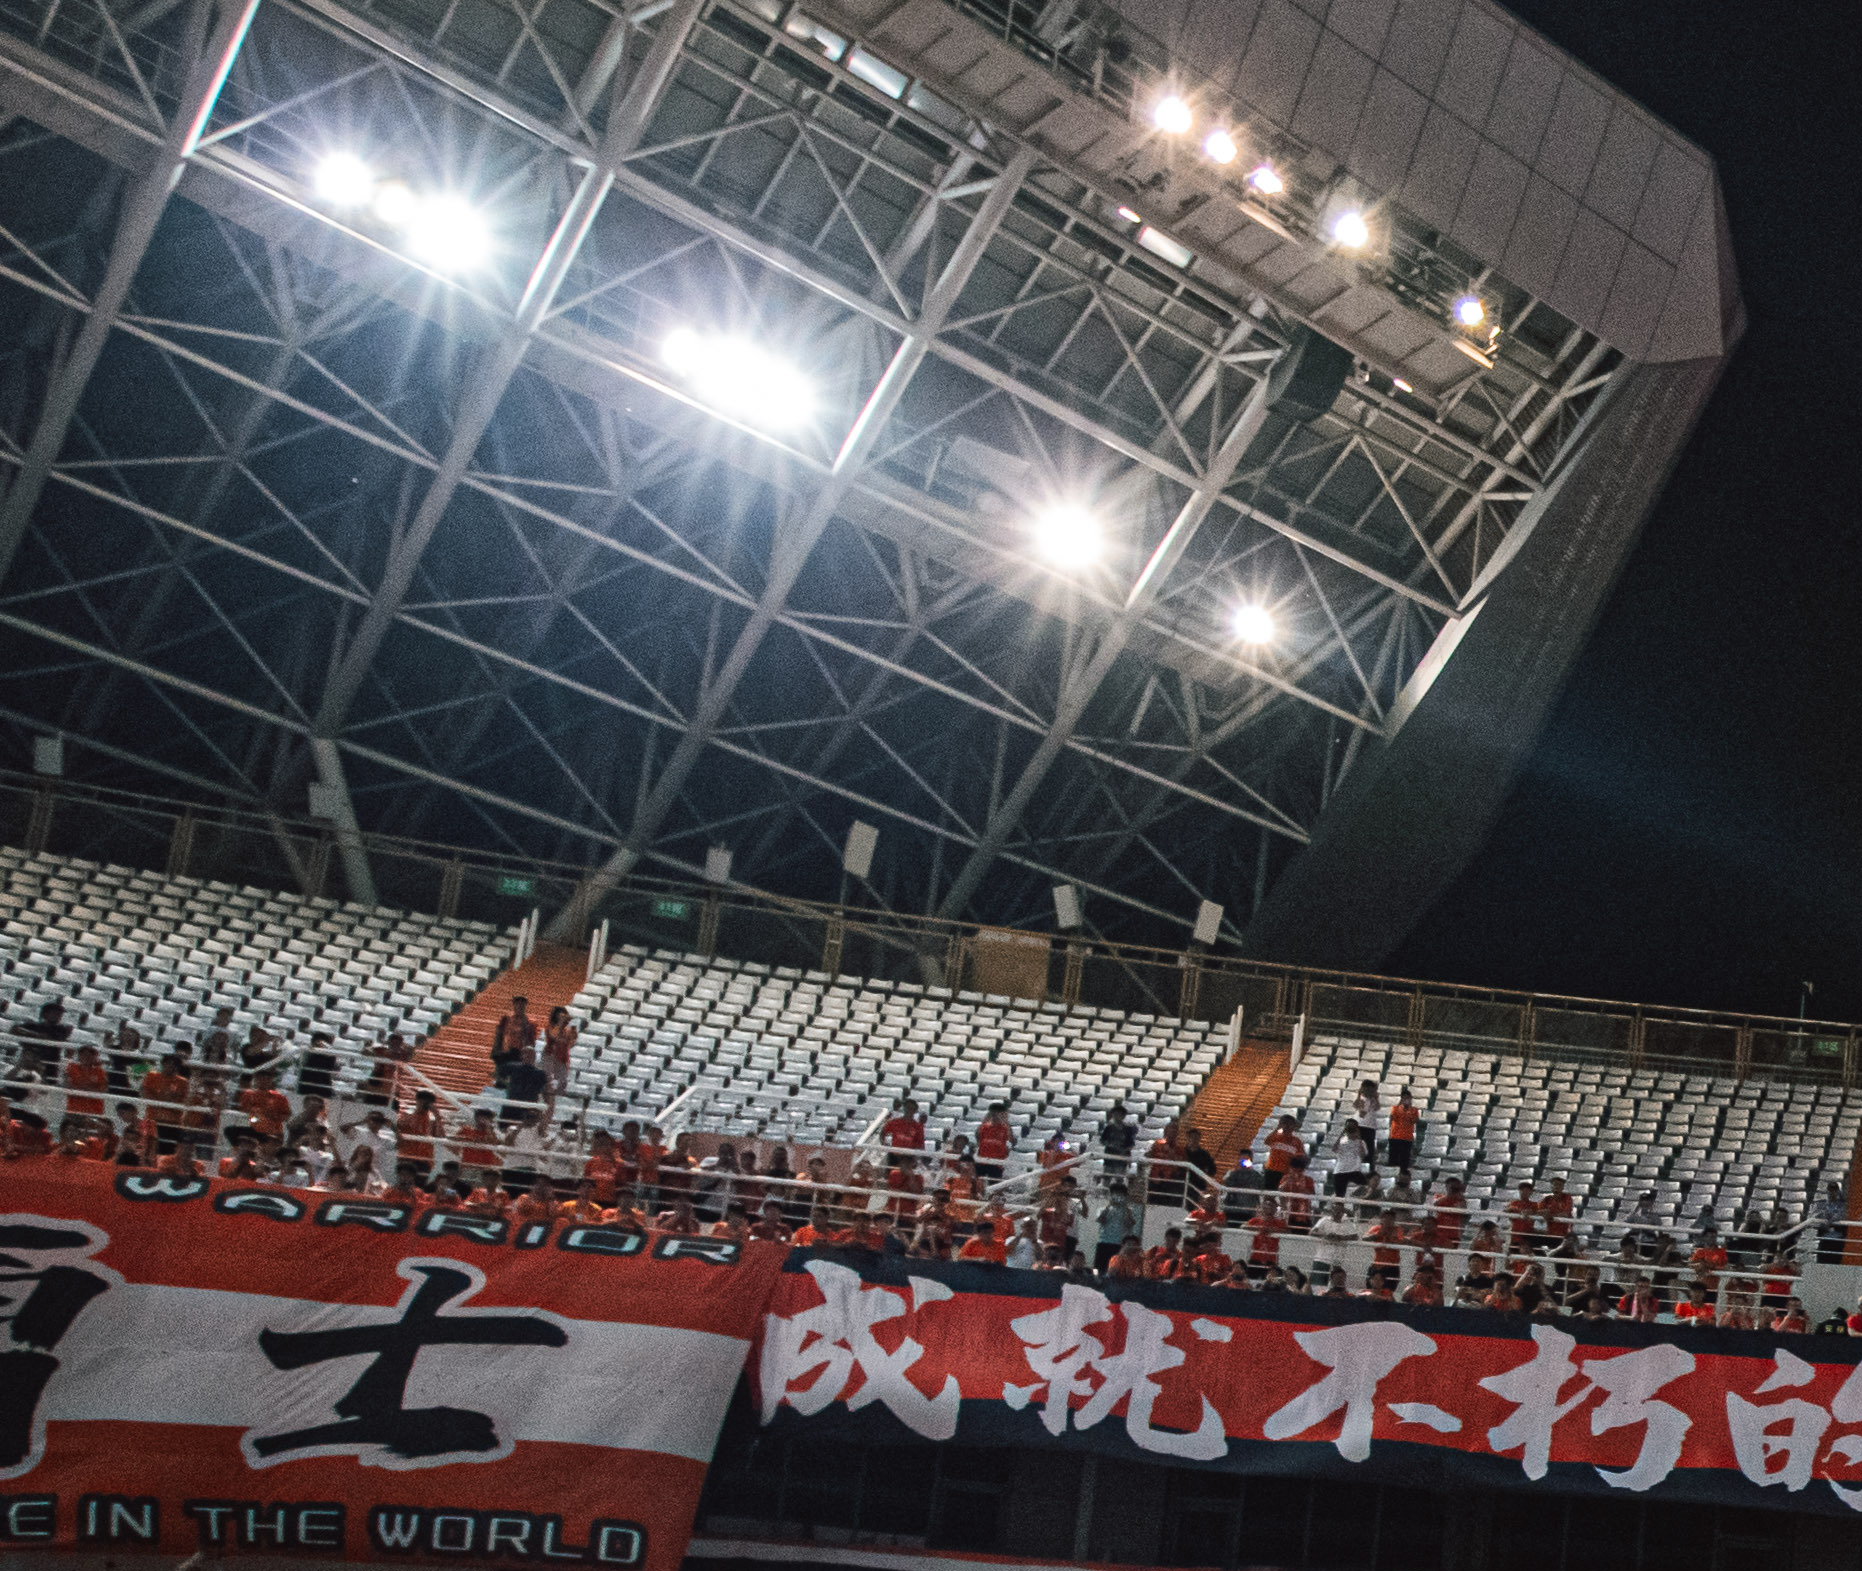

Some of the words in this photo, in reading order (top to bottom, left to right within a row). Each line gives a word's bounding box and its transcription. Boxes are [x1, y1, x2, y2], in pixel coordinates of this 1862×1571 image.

[124, 1176, 740, 1264] WARRIOR
[85, 1500, 153, 1541] IN
[192, 1506, 340, 1548] THE
[378, 1511, 645, 1565] WORLD
